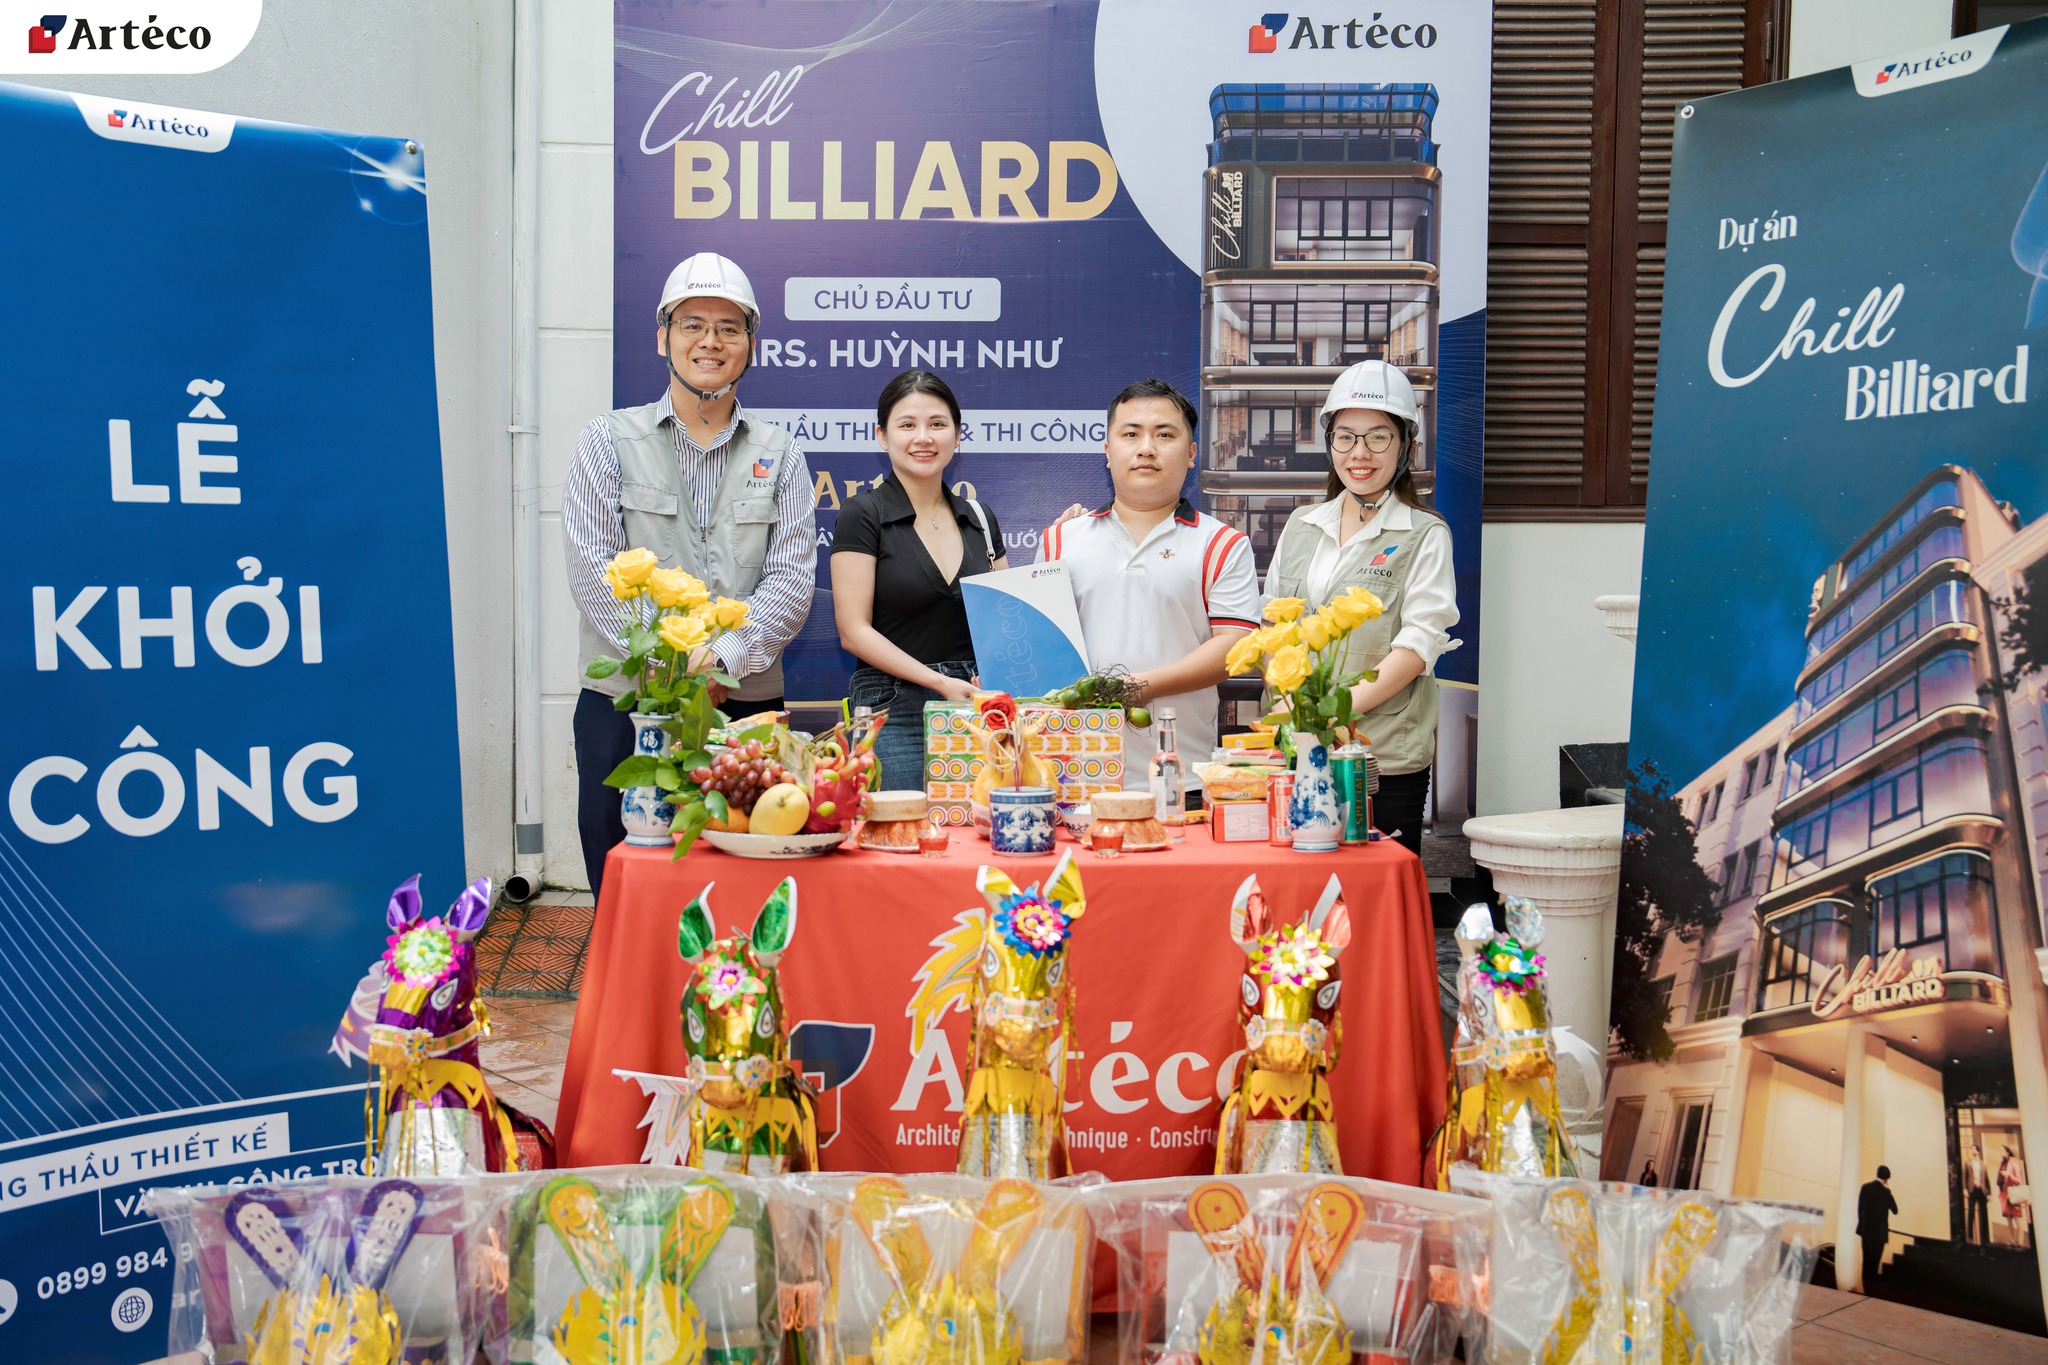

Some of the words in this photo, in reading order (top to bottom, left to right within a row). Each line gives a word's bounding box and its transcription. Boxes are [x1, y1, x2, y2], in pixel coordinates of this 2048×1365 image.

[1288, 12, 1438, 50] Artéco
[1896, 50, 1972, 79] Artéco
[131, 112, 209, 139] Artéco
[639, 64, 804, 155] Chill
[673, 140, 1118, 220] BILLIARD
[1232, 171, 1243, 228] BILLIARD
[1211, 191, 1241, 260] Chill
[1718, 216, 1759, 253] Dự
[1763, 209, 1798, 242] án
[814, 283, 869, 310] CHỦ
[875, 282, 931, 310] ĐẦU
[937, 289, 973, 310] TƯ
[751, 338, 817, 368] RS.
[830, 331, 965, 368] HUỲNH
[978, 338, 1064, 369] NHƯ
[1707, 263, 1905, 388] Chill
[1844, 344, 2030, 421] Billiard
[108, 378, 242, 504] LỄ
[835, 422, 876, 441] THI
[960, 422, 974, 442] &
[981, 423, 1022, 442] THI
[1030, 417, 1106, 442] CÔNG
[1002, 528, 1038, 549] ƯỚ
[1356, 565, 1392, 578] Artéco
[32, 556, 323, 671] KHỞI
[8, 725, 358, 844] CÔNG
[1811, 947, 1909, 1019] Chill
[1853, 977, 1945, 1013] BILLIARD
[0, 1176, 27, 1202] G
[38, 1150, 120, 1191] THẦU
[131, 1132, 220, 1171] THIẾT
[232, 1121, 269, 1153] KẾ
[895, 1122, 961, 1146] Archite
[1066, 1127, 1129, 1153] hnique
[37, 1261, 107, 1300] 0899
[116, 1246, 168, 1279] 984
